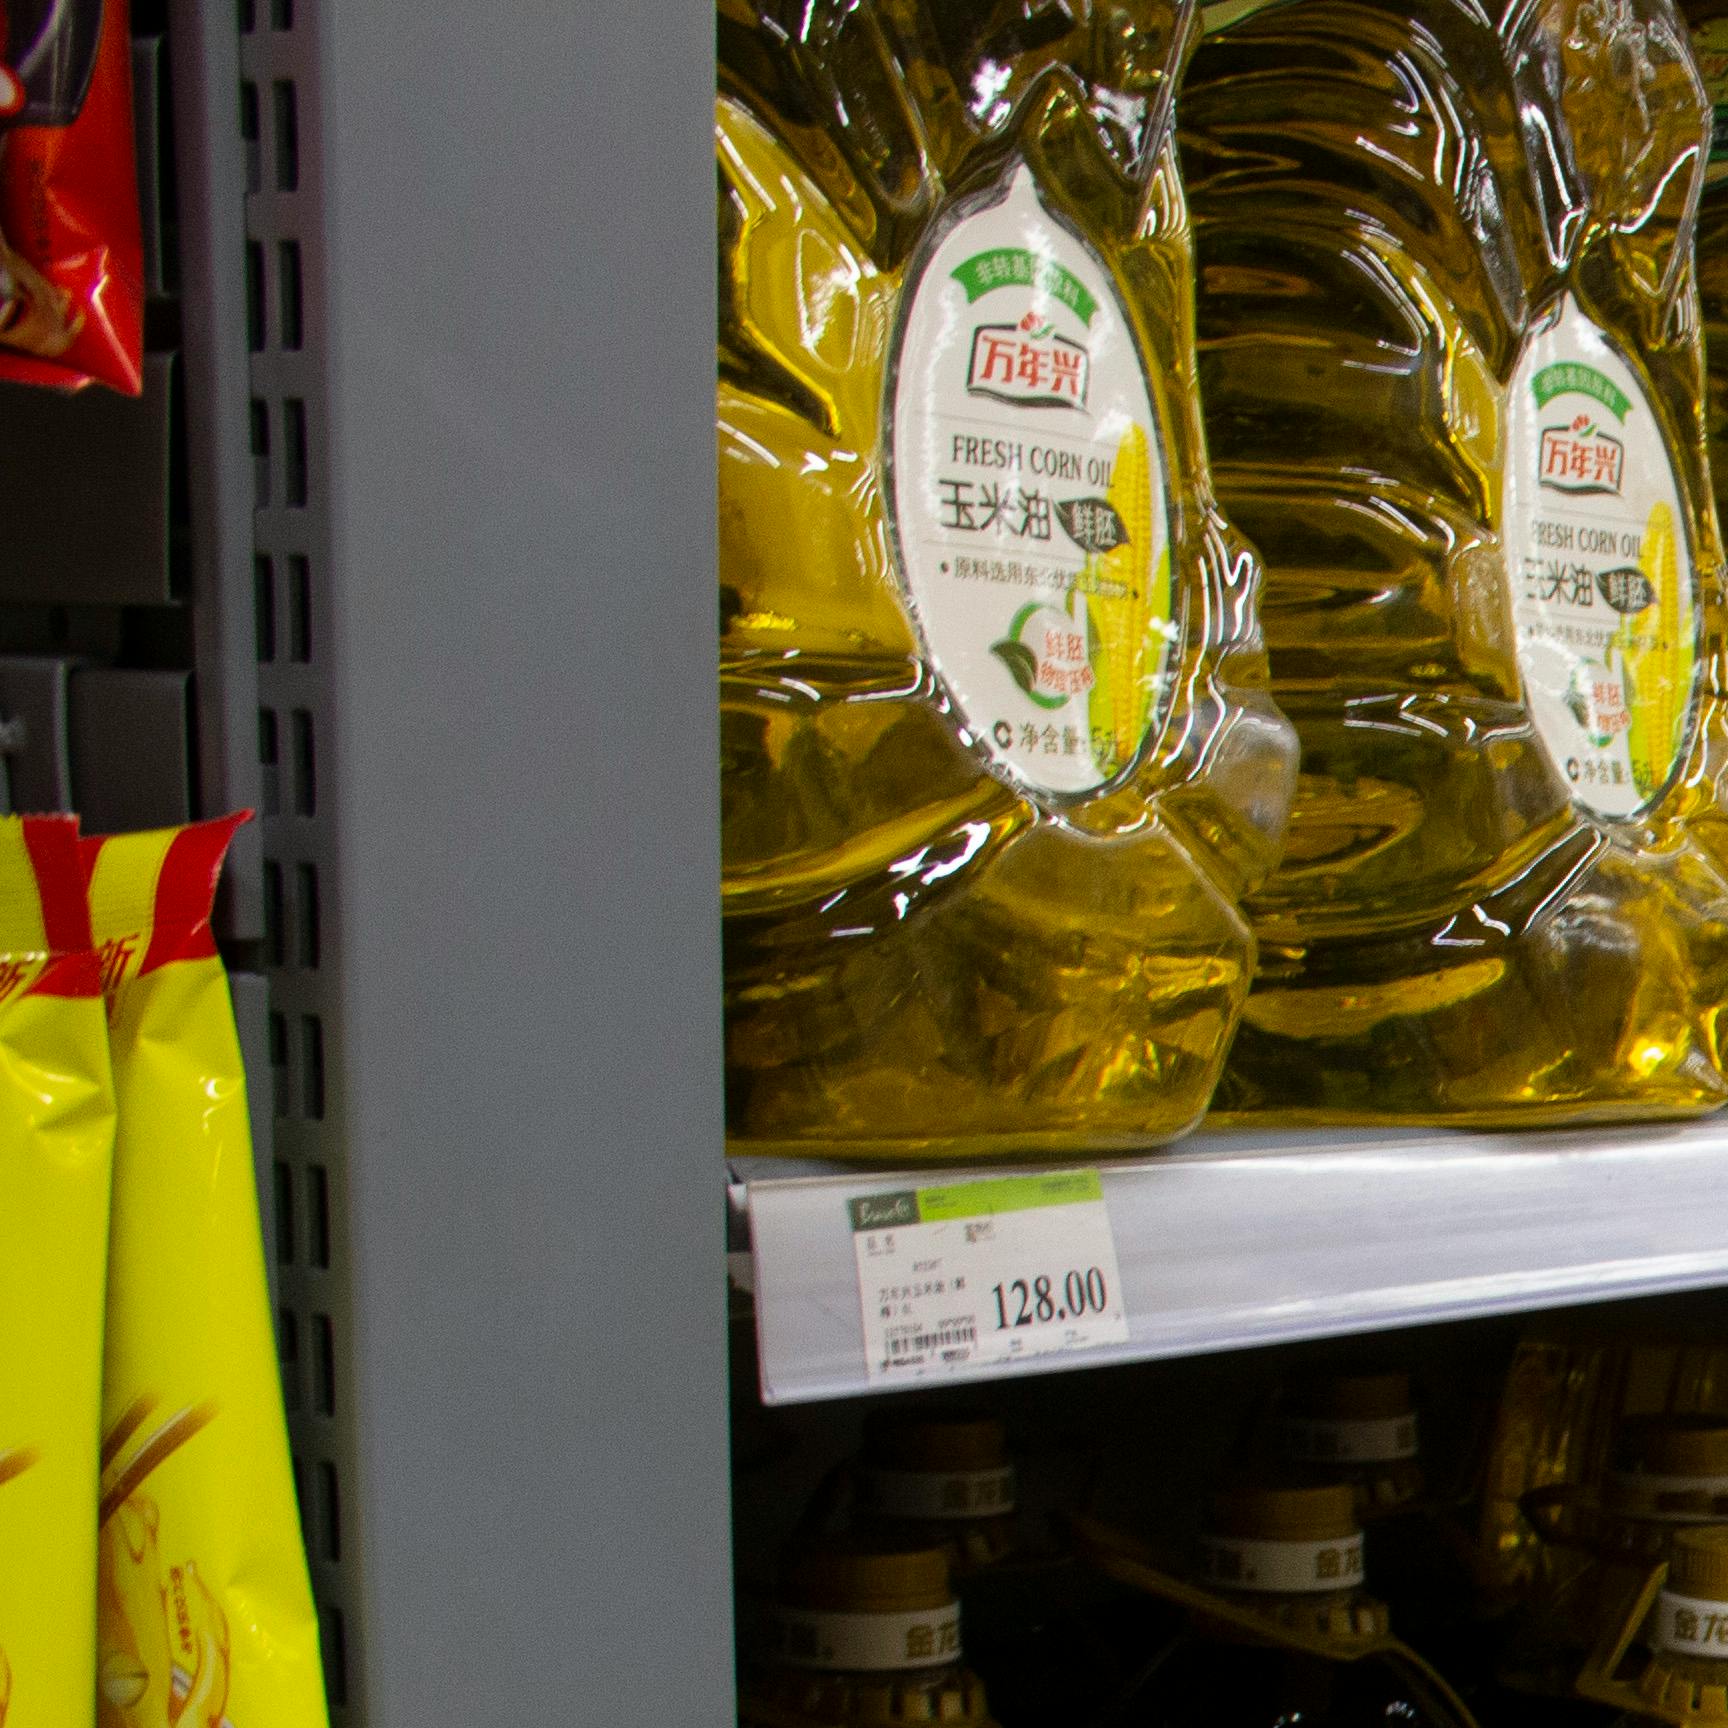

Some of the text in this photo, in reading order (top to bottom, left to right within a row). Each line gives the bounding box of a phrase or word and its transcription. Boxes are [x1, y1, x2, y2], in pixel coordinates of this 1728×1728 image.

[979, 335, 1081, 397] 万年兴
[952, 434, 1115, 489] FRESH CORN OIL
[1545, 437, 1618, 484] 万年兴
[938, 477, 1051, 541] 玉米油
[1578, 525, 1618, 554] CORN
[991, 1264, 1109, 1331] 128.00
